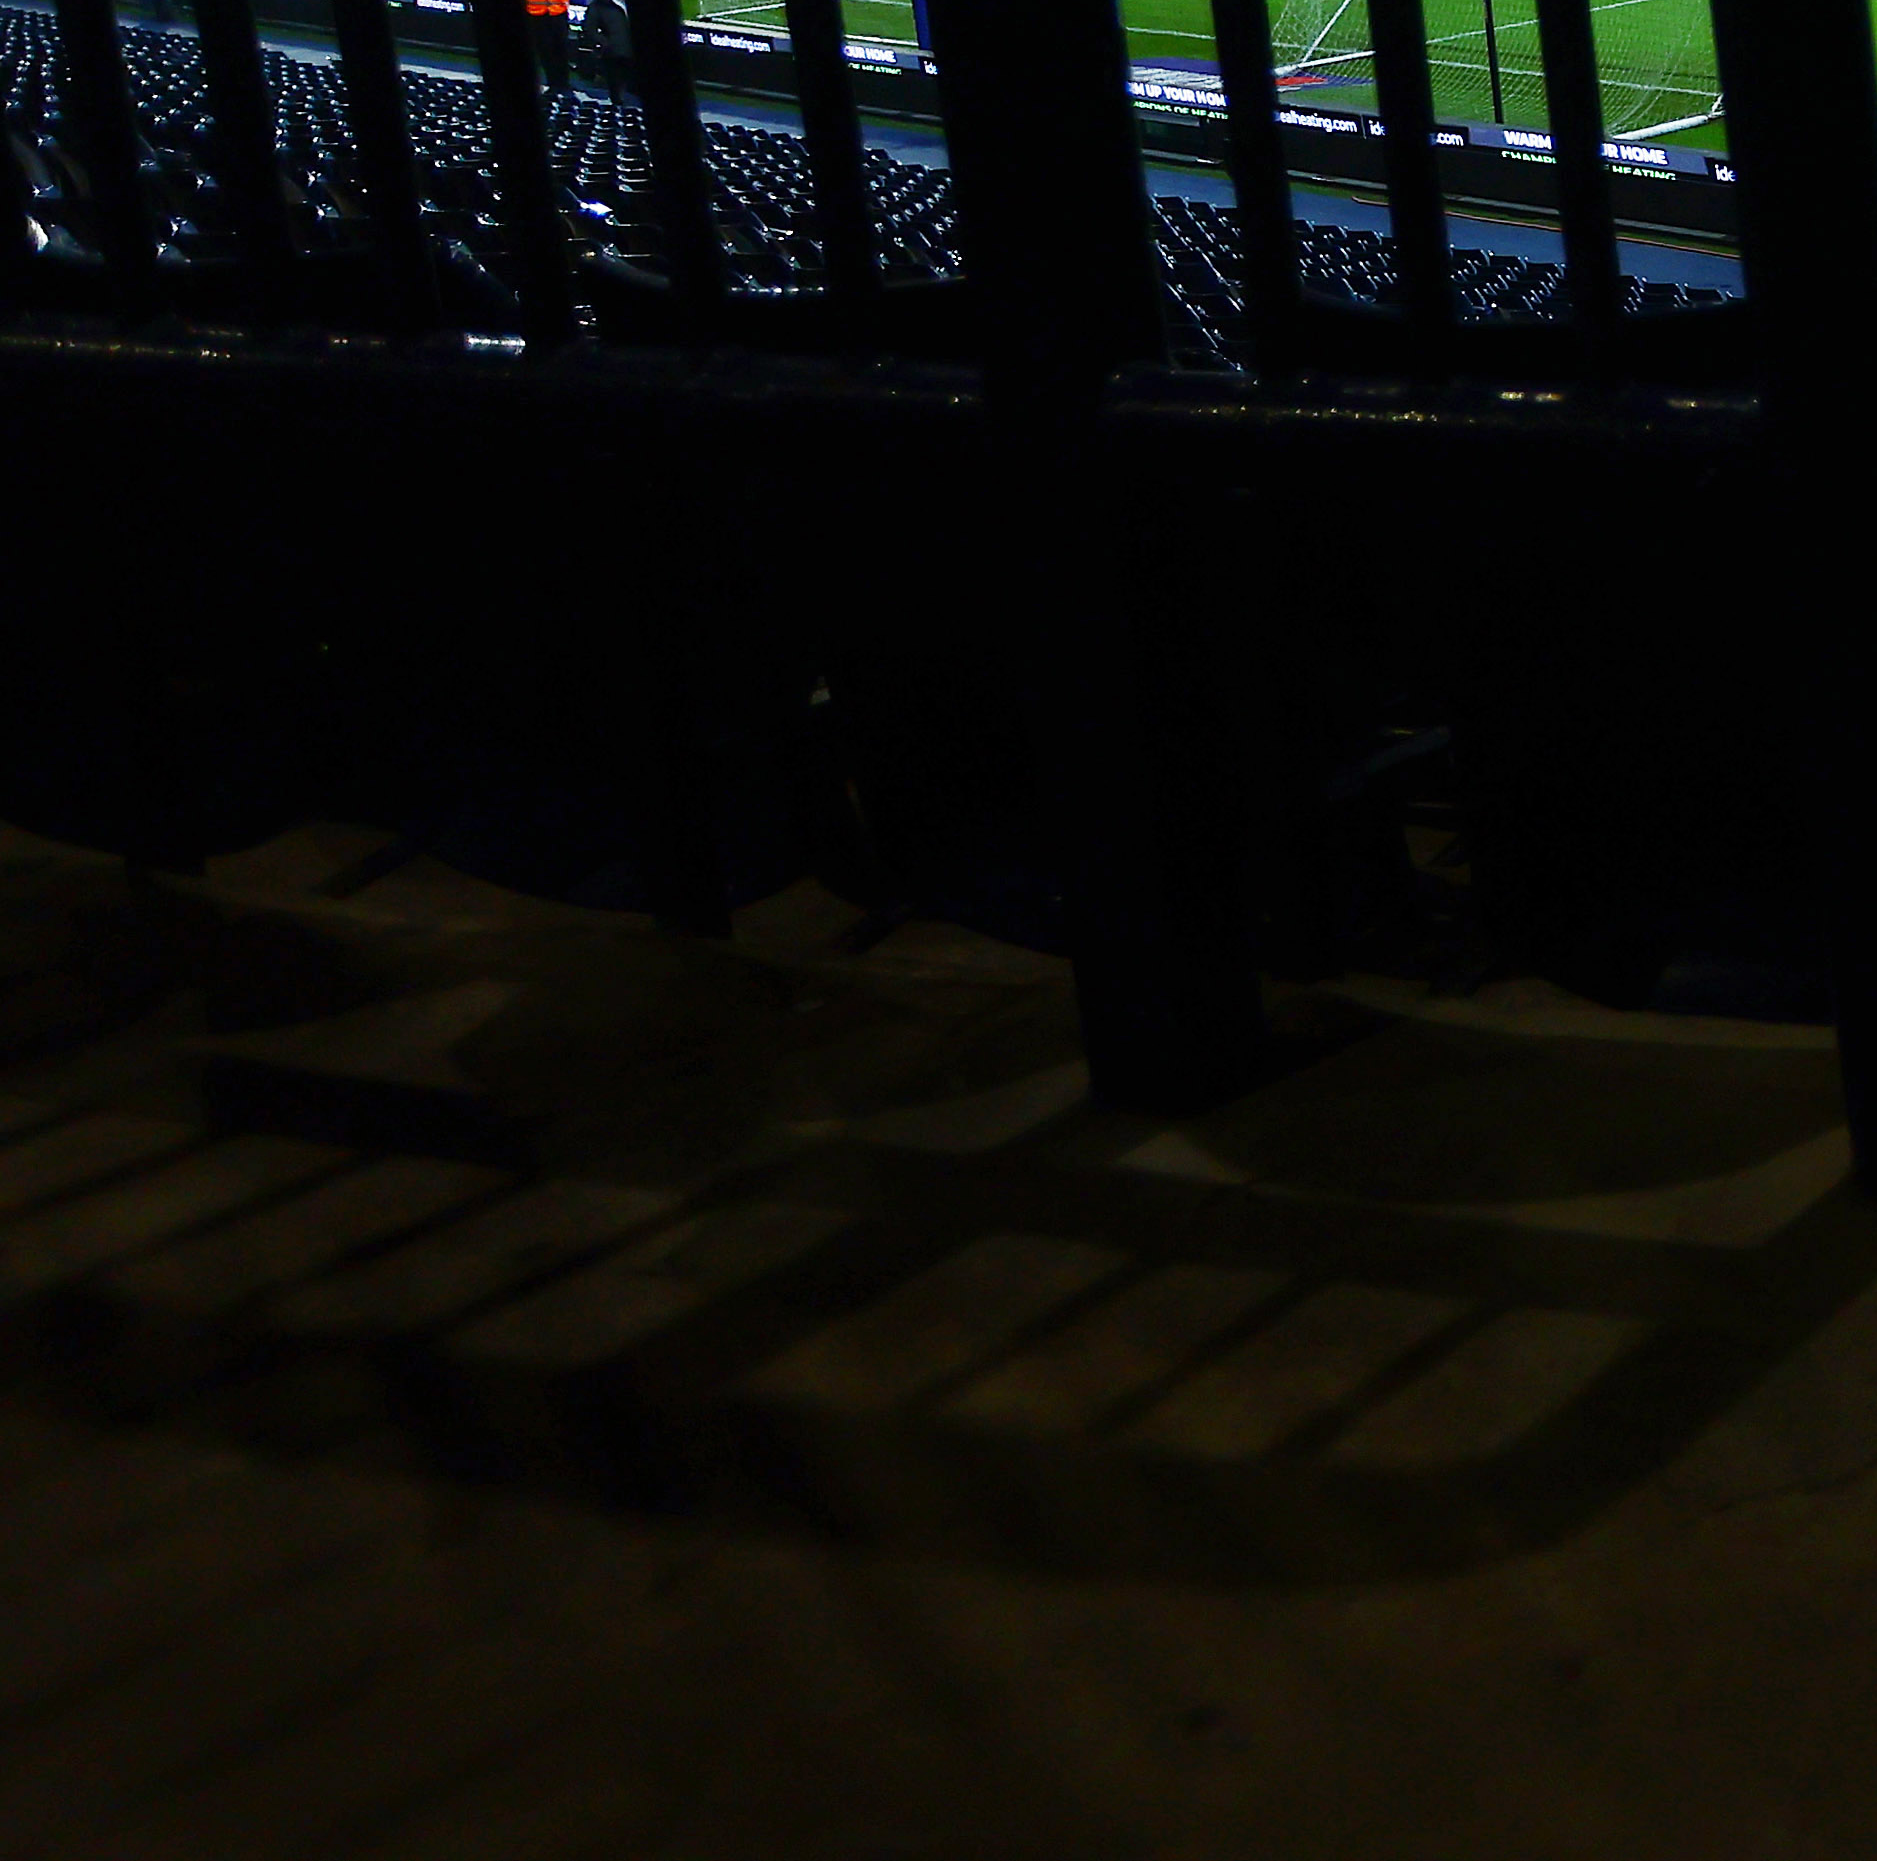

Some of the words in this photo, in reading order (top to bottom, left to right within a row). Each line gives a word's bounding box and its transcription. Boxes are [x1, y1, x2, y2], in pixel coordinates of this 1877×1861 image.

[1196, 91, 1227, 107] HOM
[1280, 110, 1358, 133] ealheating.com
[1503, 130, 1553, 150] WARM
[1622, 145, 1669, 166] HOME
